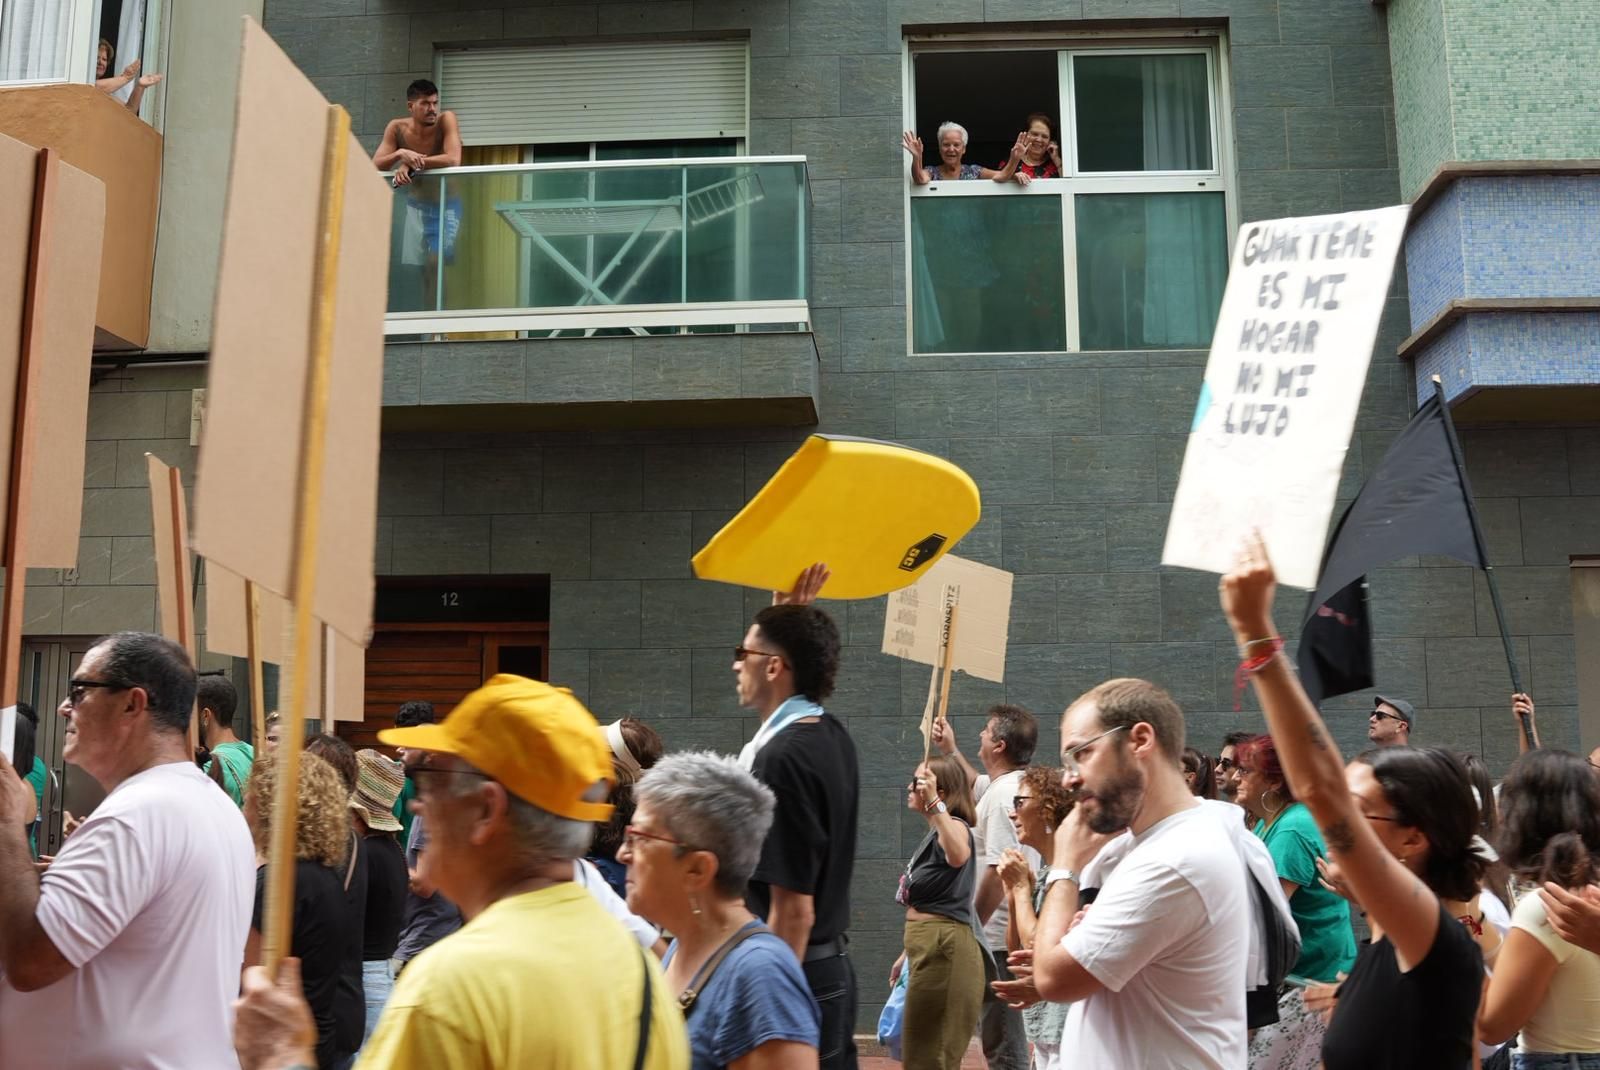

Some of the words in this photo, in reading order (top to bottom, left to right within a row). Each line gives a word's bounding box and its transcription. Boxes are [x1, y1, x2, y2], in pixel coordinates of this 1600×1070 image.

[1257, 271, 1288, 310] ES
[1300, 273, 1347, 311] MI
[1238, 318, 1320, 354] HOGAR
[1234, 361, 1263, 395] NO
[1272, 364, 1316, 398] MI
[1224, 402, 1290, 437] LUJO
[441, 592, 459, 606] 12
